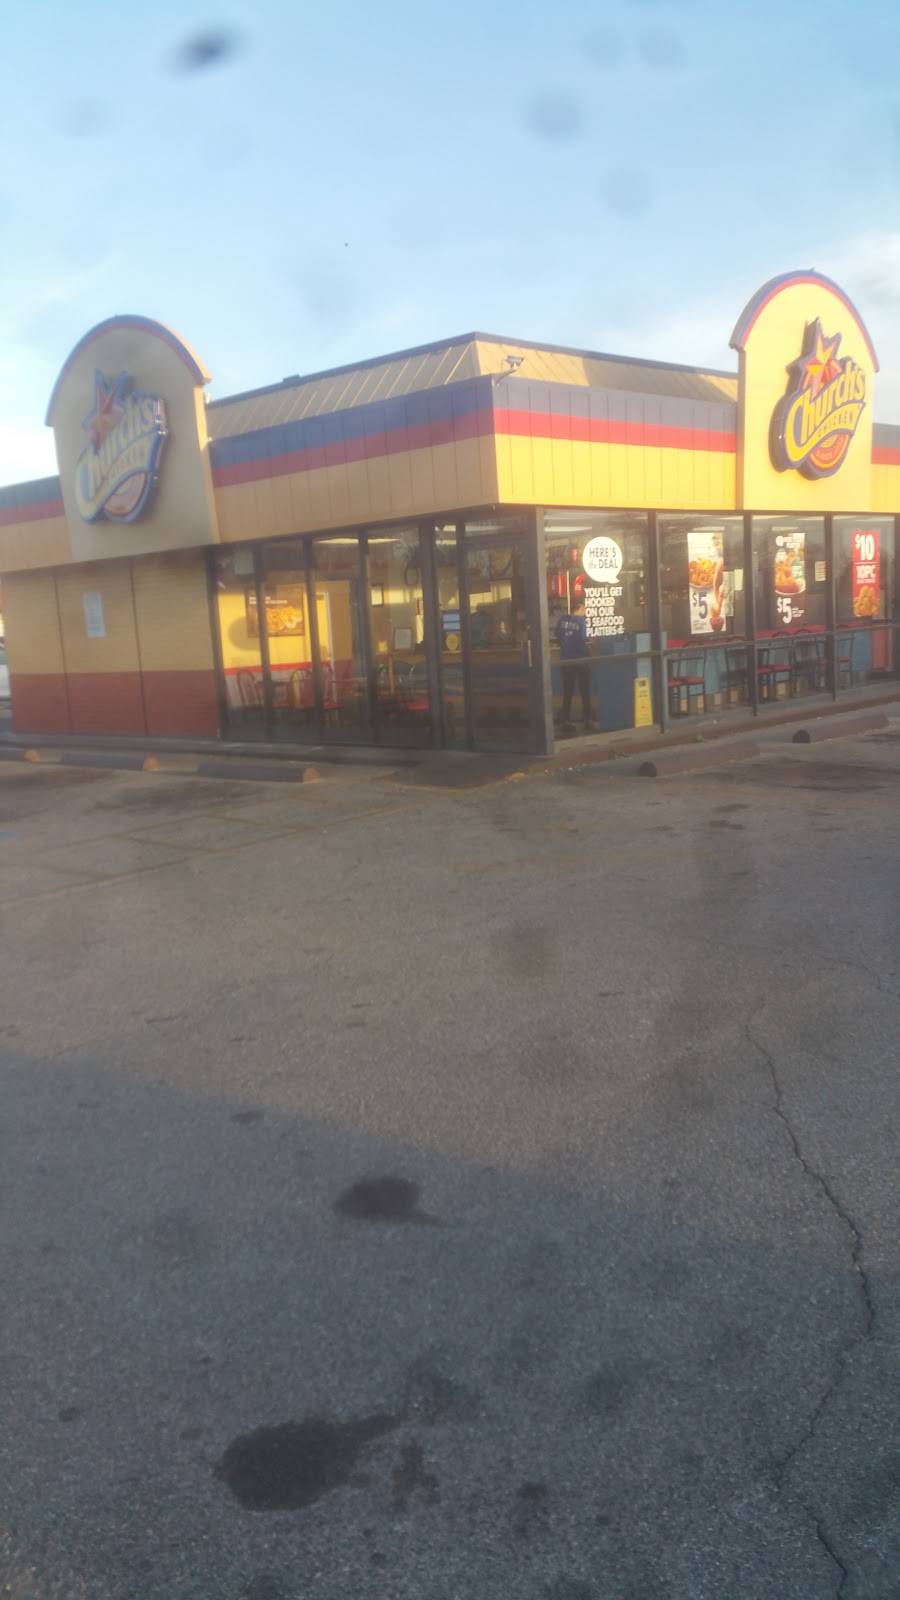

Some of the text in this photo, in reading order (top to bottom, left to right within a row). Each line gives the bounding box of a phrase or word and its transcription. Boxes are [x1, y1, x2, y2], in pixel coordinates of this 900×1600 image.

[589, 547, 617, 558] HERE'S
[855, 533, 875, 561] $10
[598, 558, 619, 569] DEAL
[584, 586, 623, 598] YOU'LL GET
[584, 597, 616, 608] HOOKED
[692, 591, 709, 620] $5
[585, 607, 615, 617] ON OUR
[776, 596, 792, 624] $5
[585, 617, 592, 628] 3
[592, 615, 625, 627] SEAFOOD
[585, 626, 617, 638] PLATTERS
